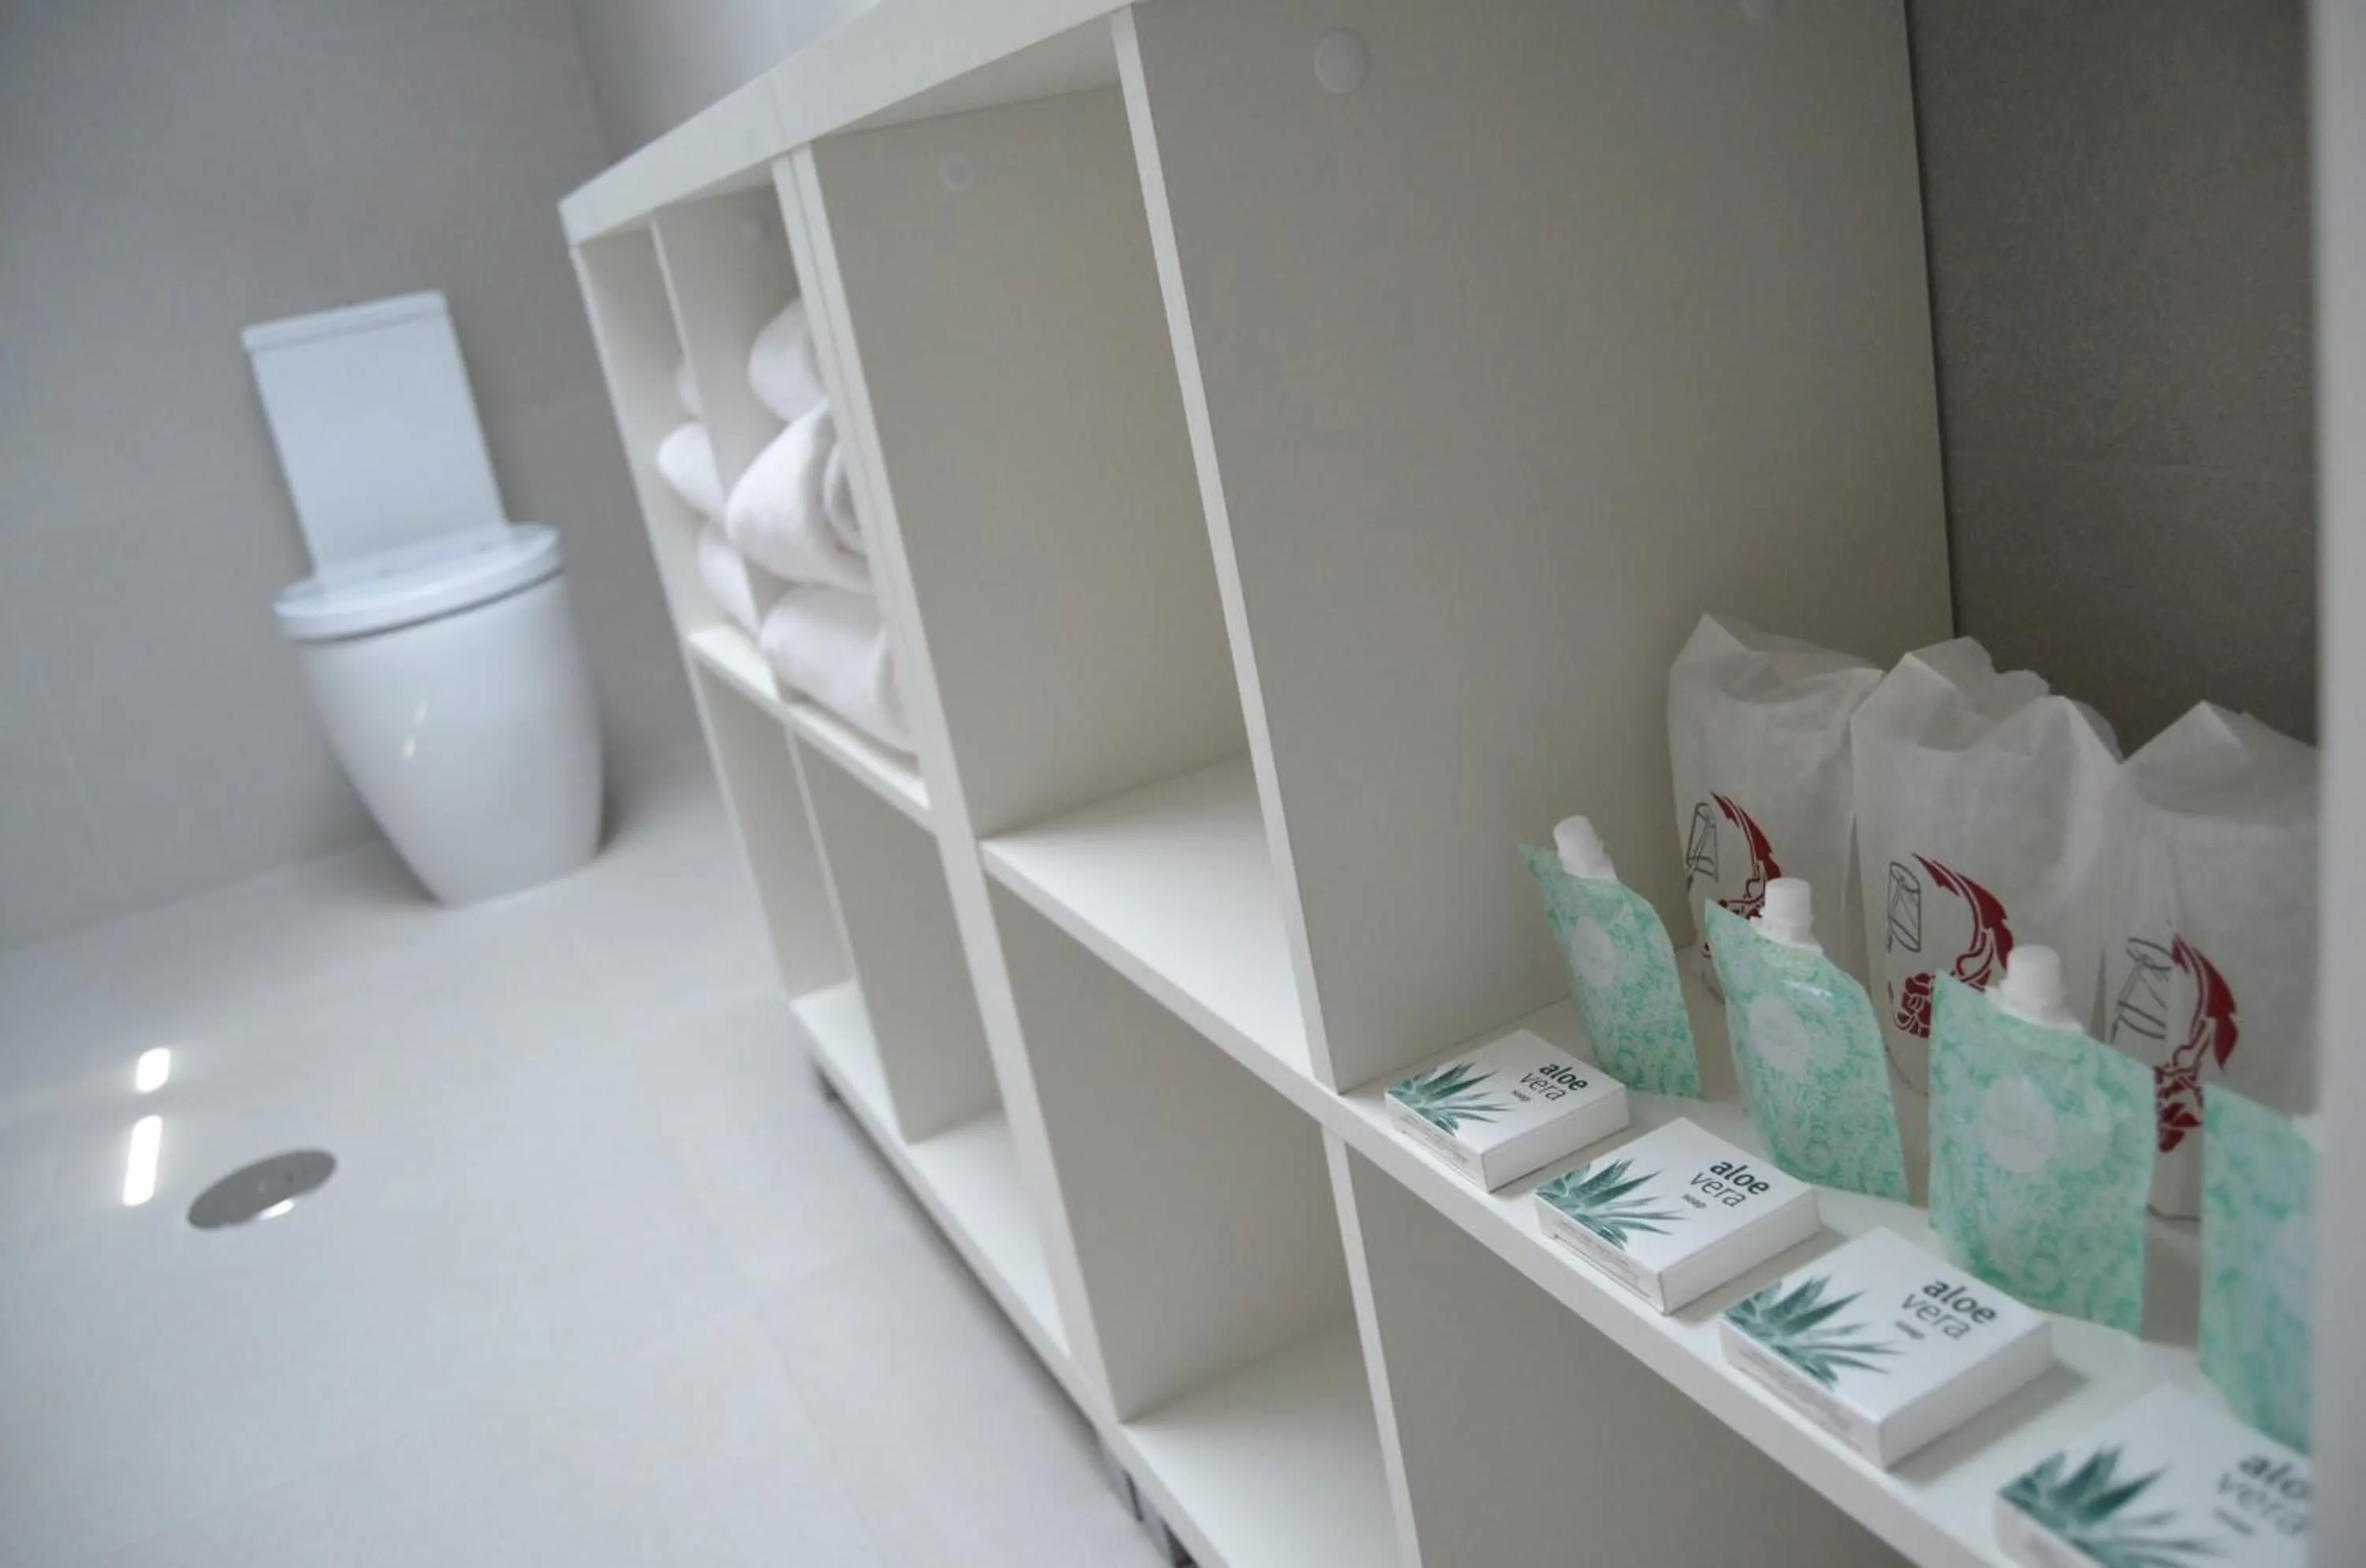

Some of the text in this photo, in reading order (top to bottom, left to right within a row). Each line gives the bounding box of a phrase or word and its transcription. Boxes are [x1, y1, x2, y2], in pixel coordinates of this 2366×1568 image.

[1520, 1073, 1566, 1101] vera
[1539, 1063, 1588, 1091] aloe
[1690, 1172, 1746, 1207] vera
[1710, 1161, 1769, 1195] aloe
[1901, 1294, 1971, 1339] vera
[1923, 1280, 1996, 1324] aloe
[2237, 1454, 2311, 1500] alo
